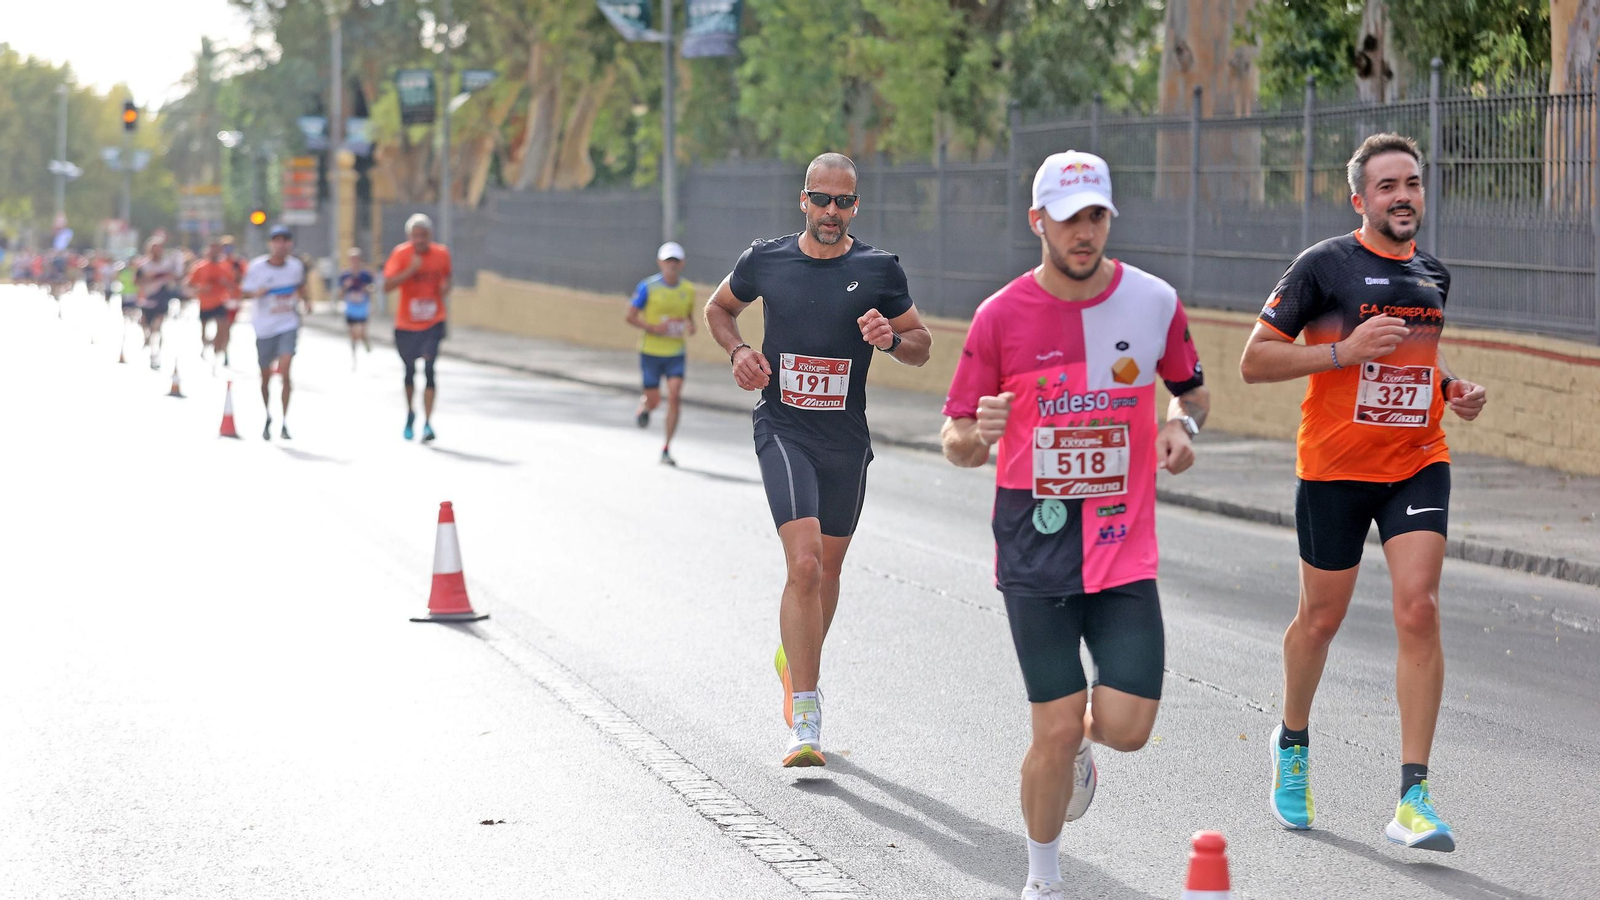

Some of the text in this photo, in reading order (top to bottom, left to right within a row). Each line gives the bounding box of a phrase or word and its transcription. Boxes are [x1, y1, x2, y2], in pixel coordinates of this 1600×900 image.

[1060, 175, 1100, 186] Red Bull
[796, 374, 830, 393] 191
[1037, 389, 1110, 418] indeso
[1378, 386, 1417, 406] 327
[1385, 412, 1425, 423] MIZUN
[1058, 451, 1106, 475] 518
